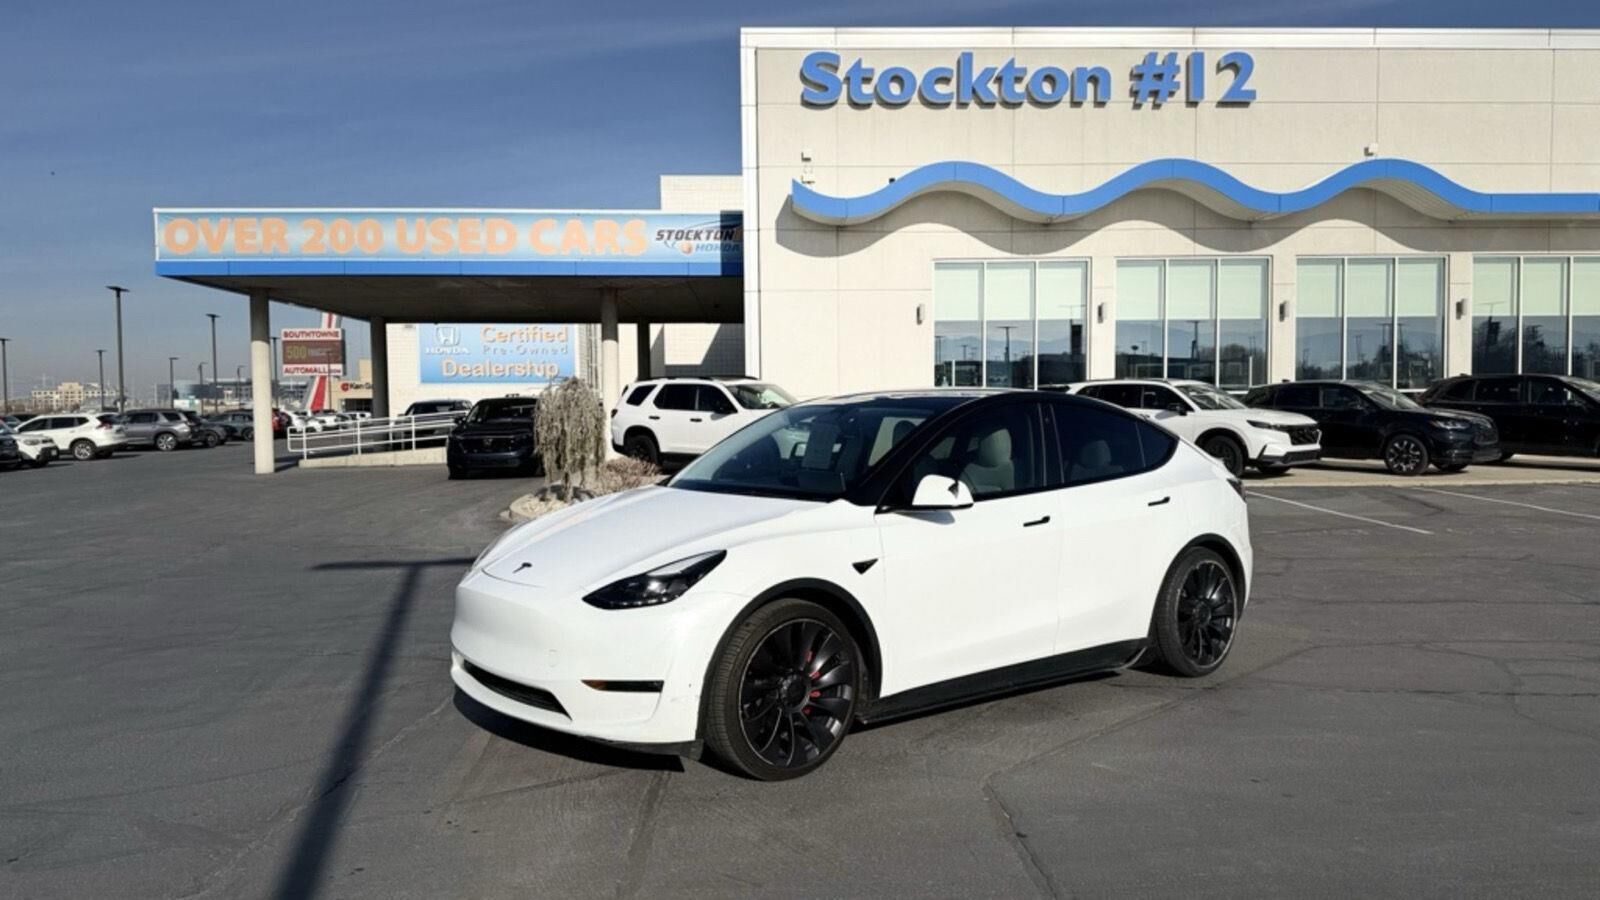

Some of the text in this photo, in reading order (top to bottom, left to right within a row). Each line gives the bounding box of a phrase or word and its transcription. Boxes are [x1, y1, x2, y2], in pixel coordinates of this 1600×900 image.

[801, 51, 1256, 106] Stockton #12
[164, 217, 648, 255] OVER 200 USED CARS
[655, 229, 735, 242] STOCKTON
[695, 244, 739, 252] HONDA
[481, 327, 569, 344] Certified
[425, 347, 470, 356] HONDA
[482, 345, 569, 355] Pre-Owned
[442, 359, 559, 379] Dealership
